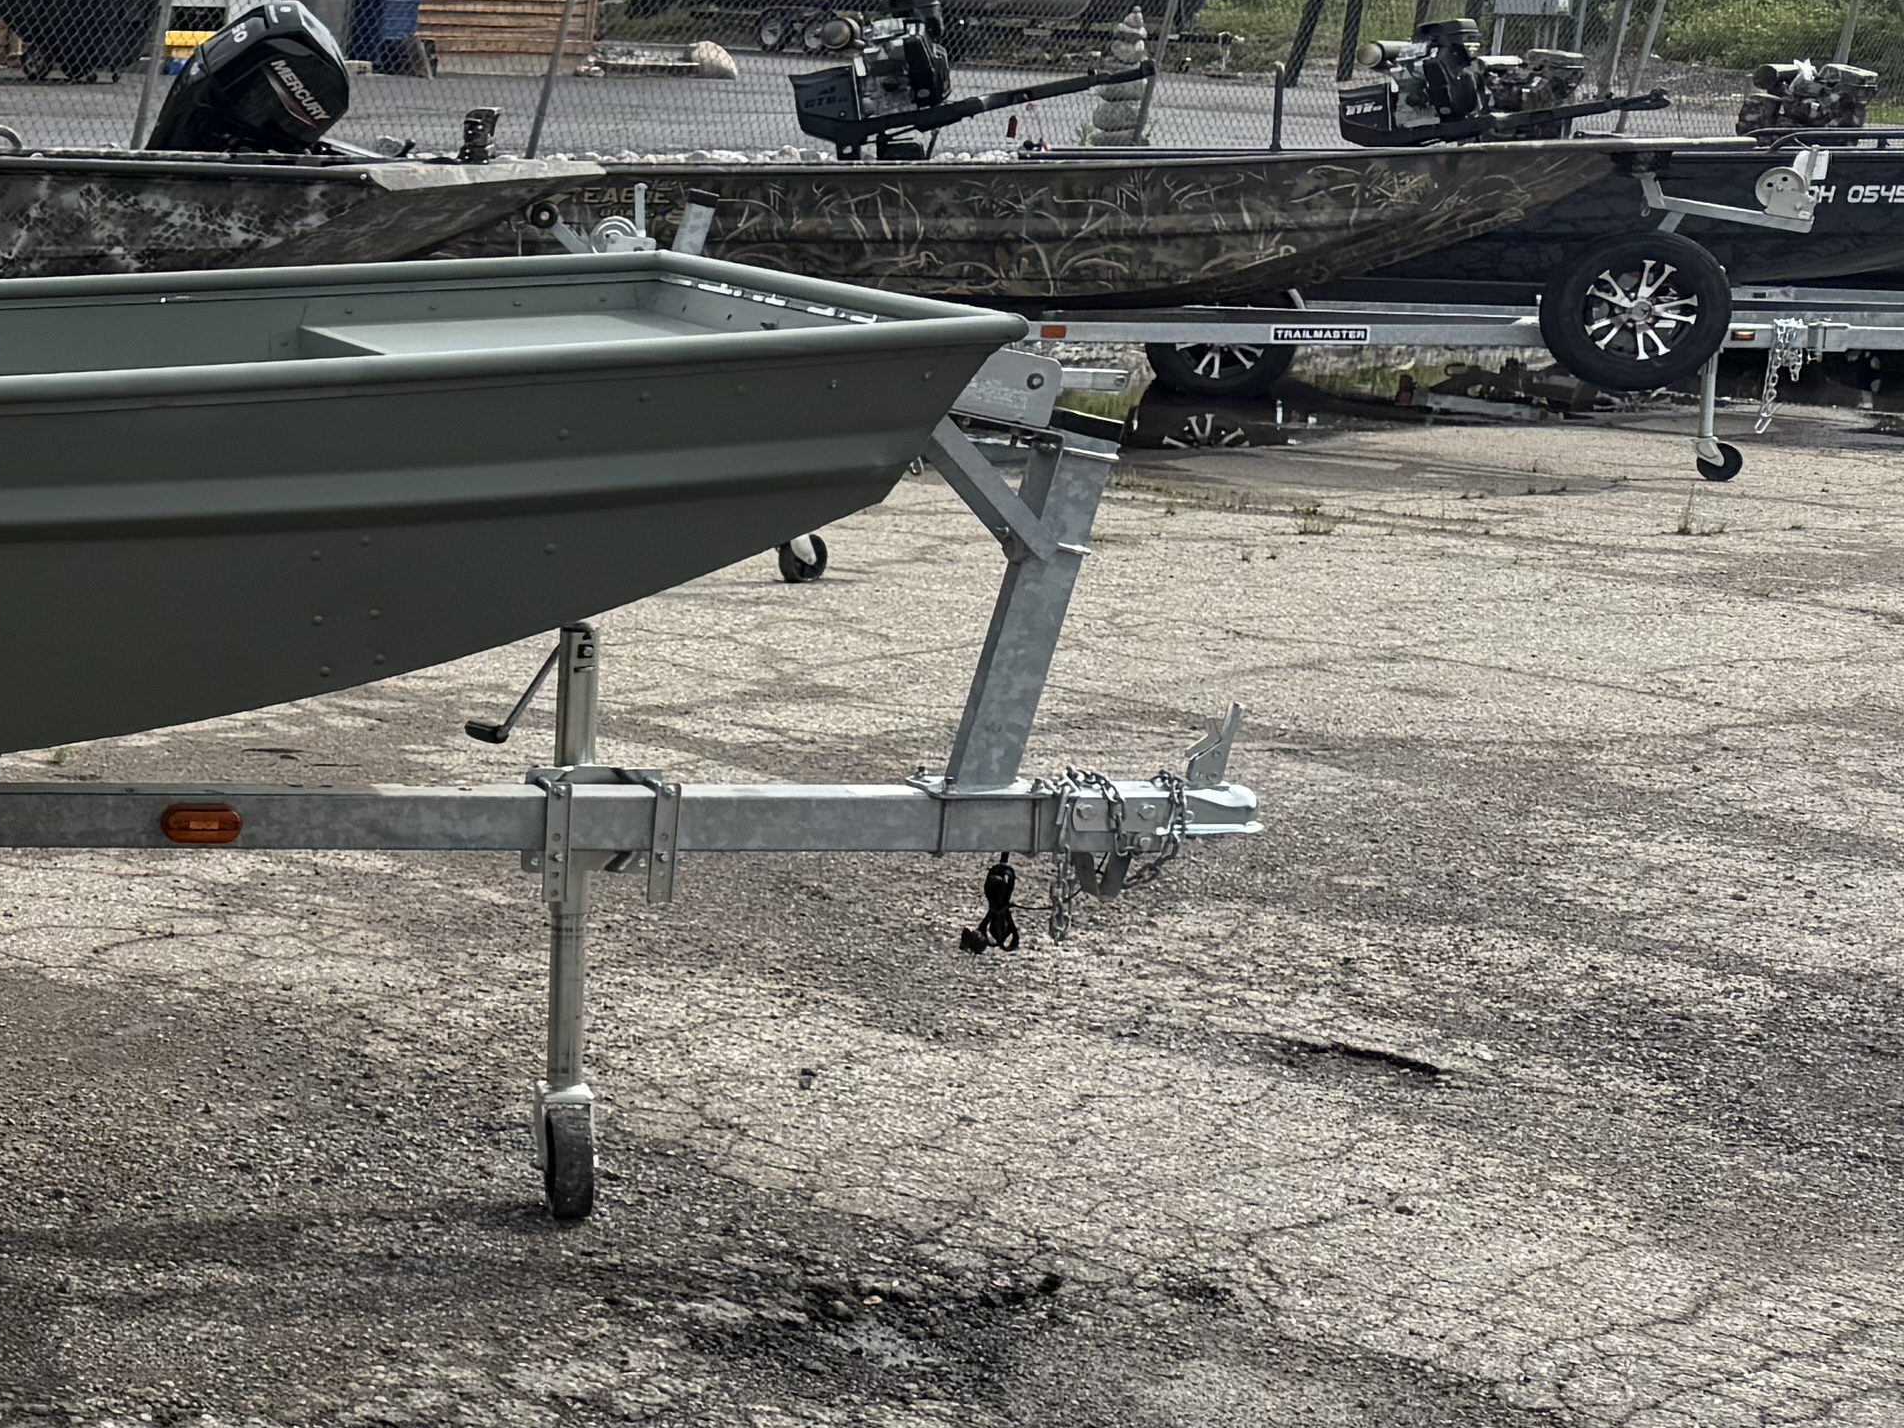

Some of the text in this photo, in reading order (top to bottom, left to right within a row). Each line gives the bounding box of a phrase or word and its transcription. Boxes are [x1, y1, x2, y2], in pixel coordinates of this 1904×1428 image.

[270, 59, 331, 121] MERCURY
[583, 187, 673, 204] EAGE
[1275, 329, 1366, 339] TRAILMASTER
